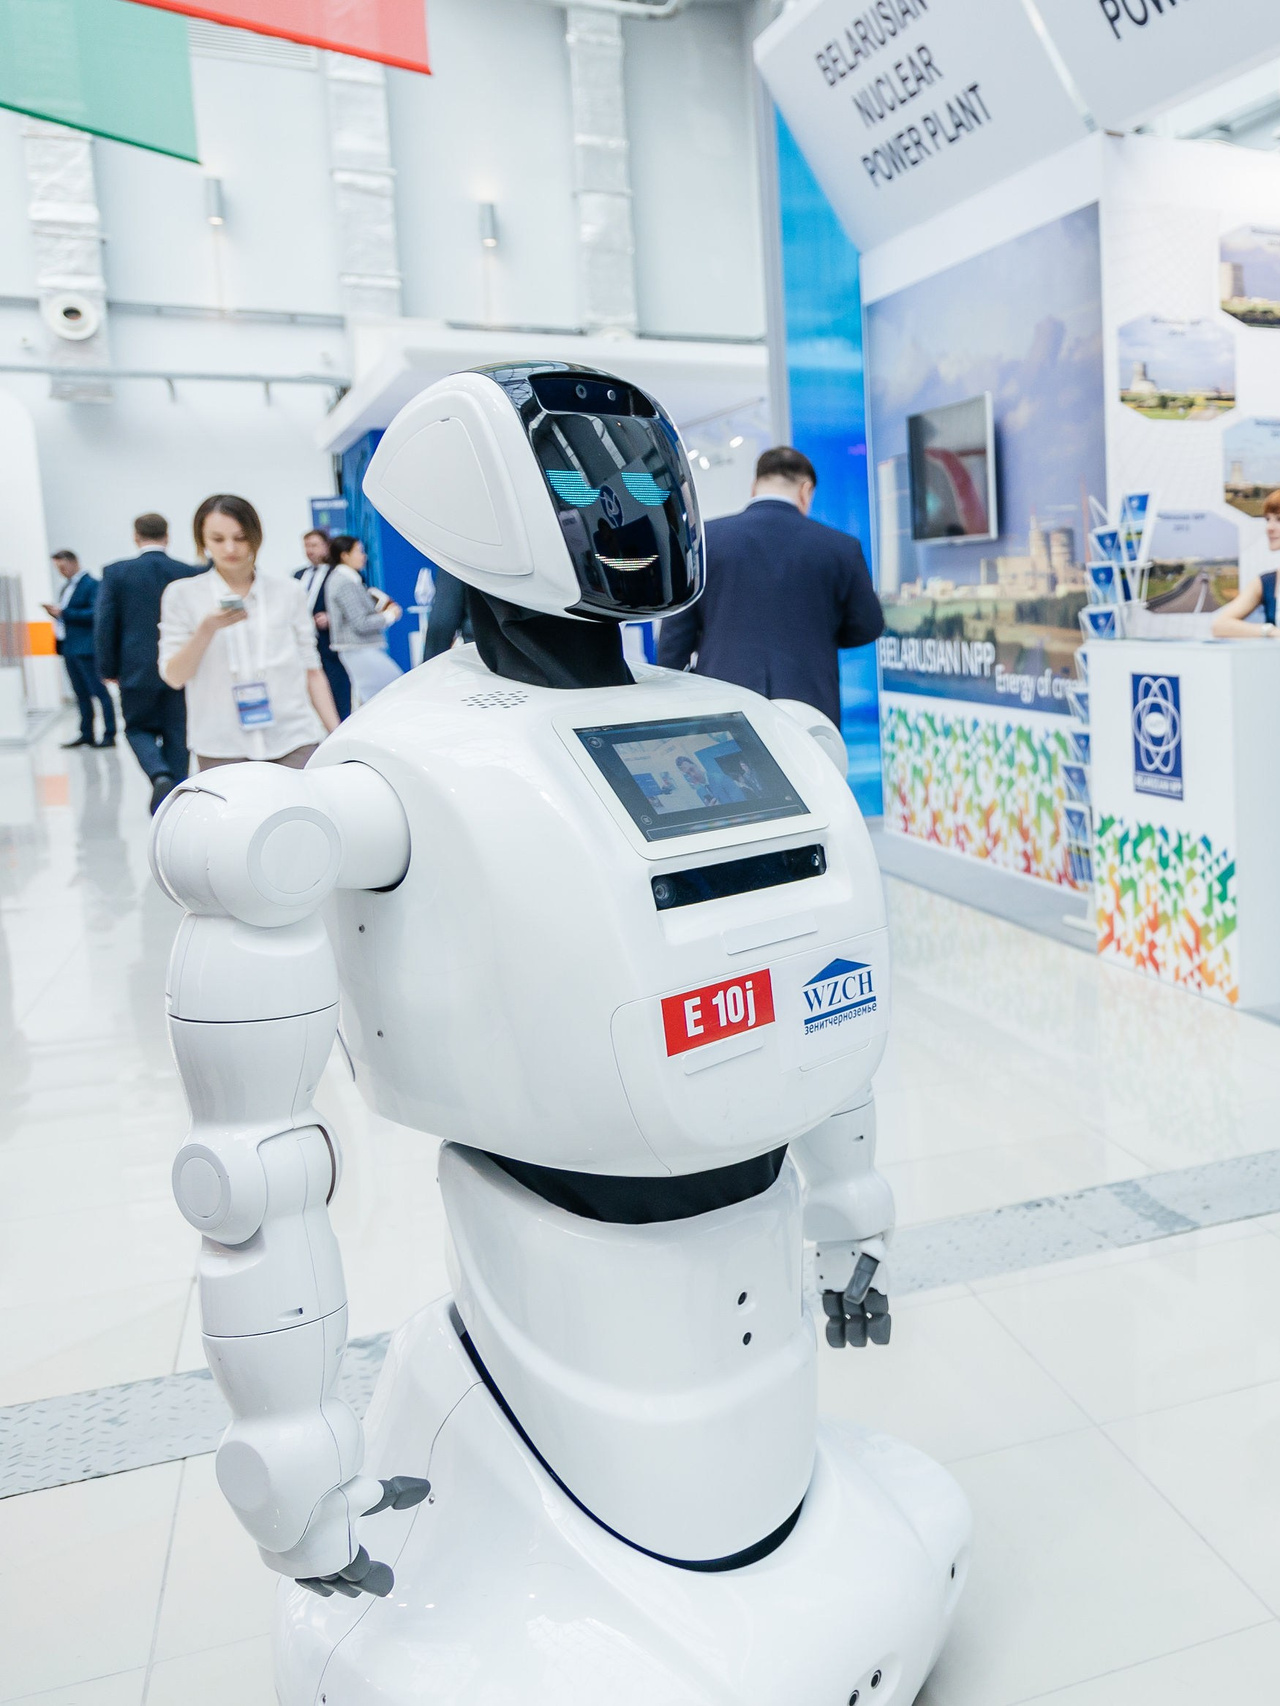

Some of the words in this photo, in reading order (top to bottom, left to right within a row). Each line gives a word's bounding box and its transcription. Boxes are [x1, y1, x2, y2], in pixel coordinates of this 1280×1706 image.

[852, 44, 943, 128] NUCLEAR
[861, 125, 933, 188] POWER
[922, 82, 991, 151] PLANT
[878, 636, 961, 676] BELARUSIAN
[962, 641, 996, 678] NPP
[995, 663, 1035, 704] Energy
[1036, 667, 1053, 699] of
[684, 996, 705, 1038] E
[711, 980, 757, 1028] 10j
[803, 969, 874, 1013] WZCH
[804, 1002, 877, 1036] зенитчерноземье
